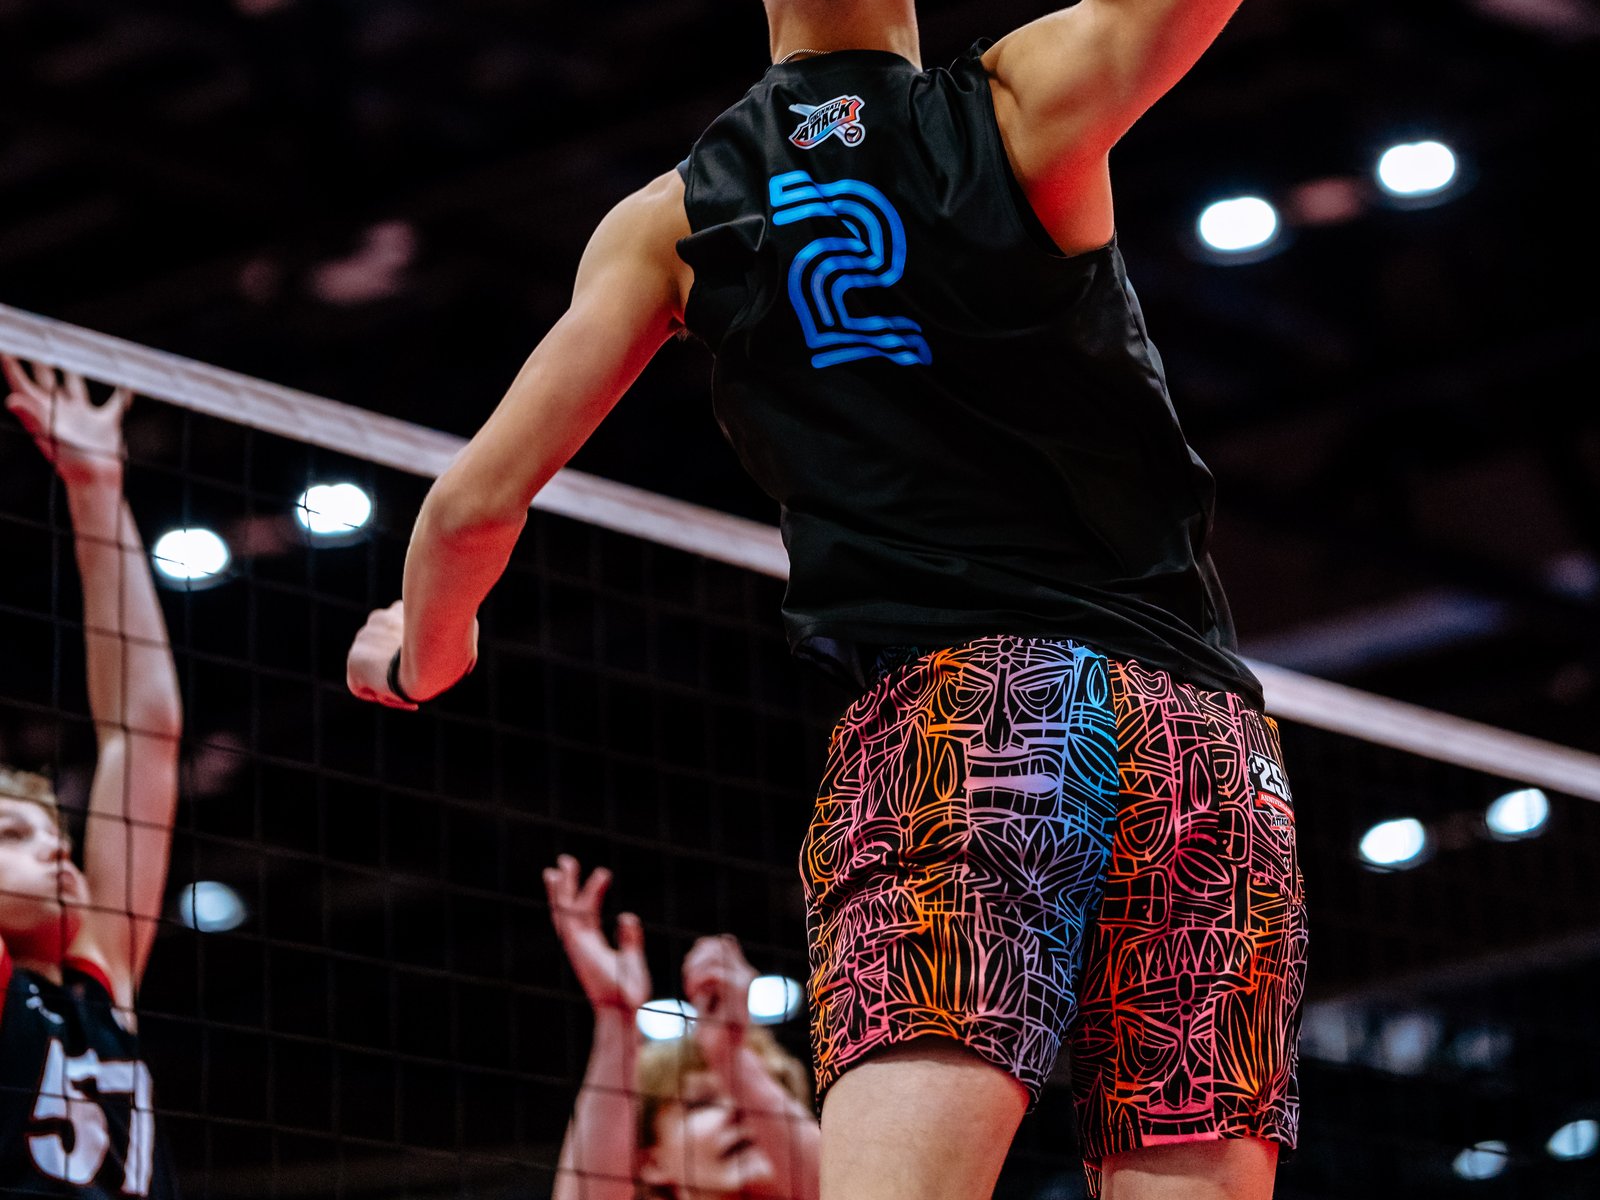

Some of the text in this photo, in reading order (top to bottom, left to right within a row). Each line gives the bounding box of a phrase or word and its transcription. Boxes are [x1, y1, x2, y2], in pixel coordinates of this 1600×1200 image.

[797, 101, 854, 141] ATTACK
[769, 170, 932, 368] 2
[29, 1038, 154, 1198] 57
